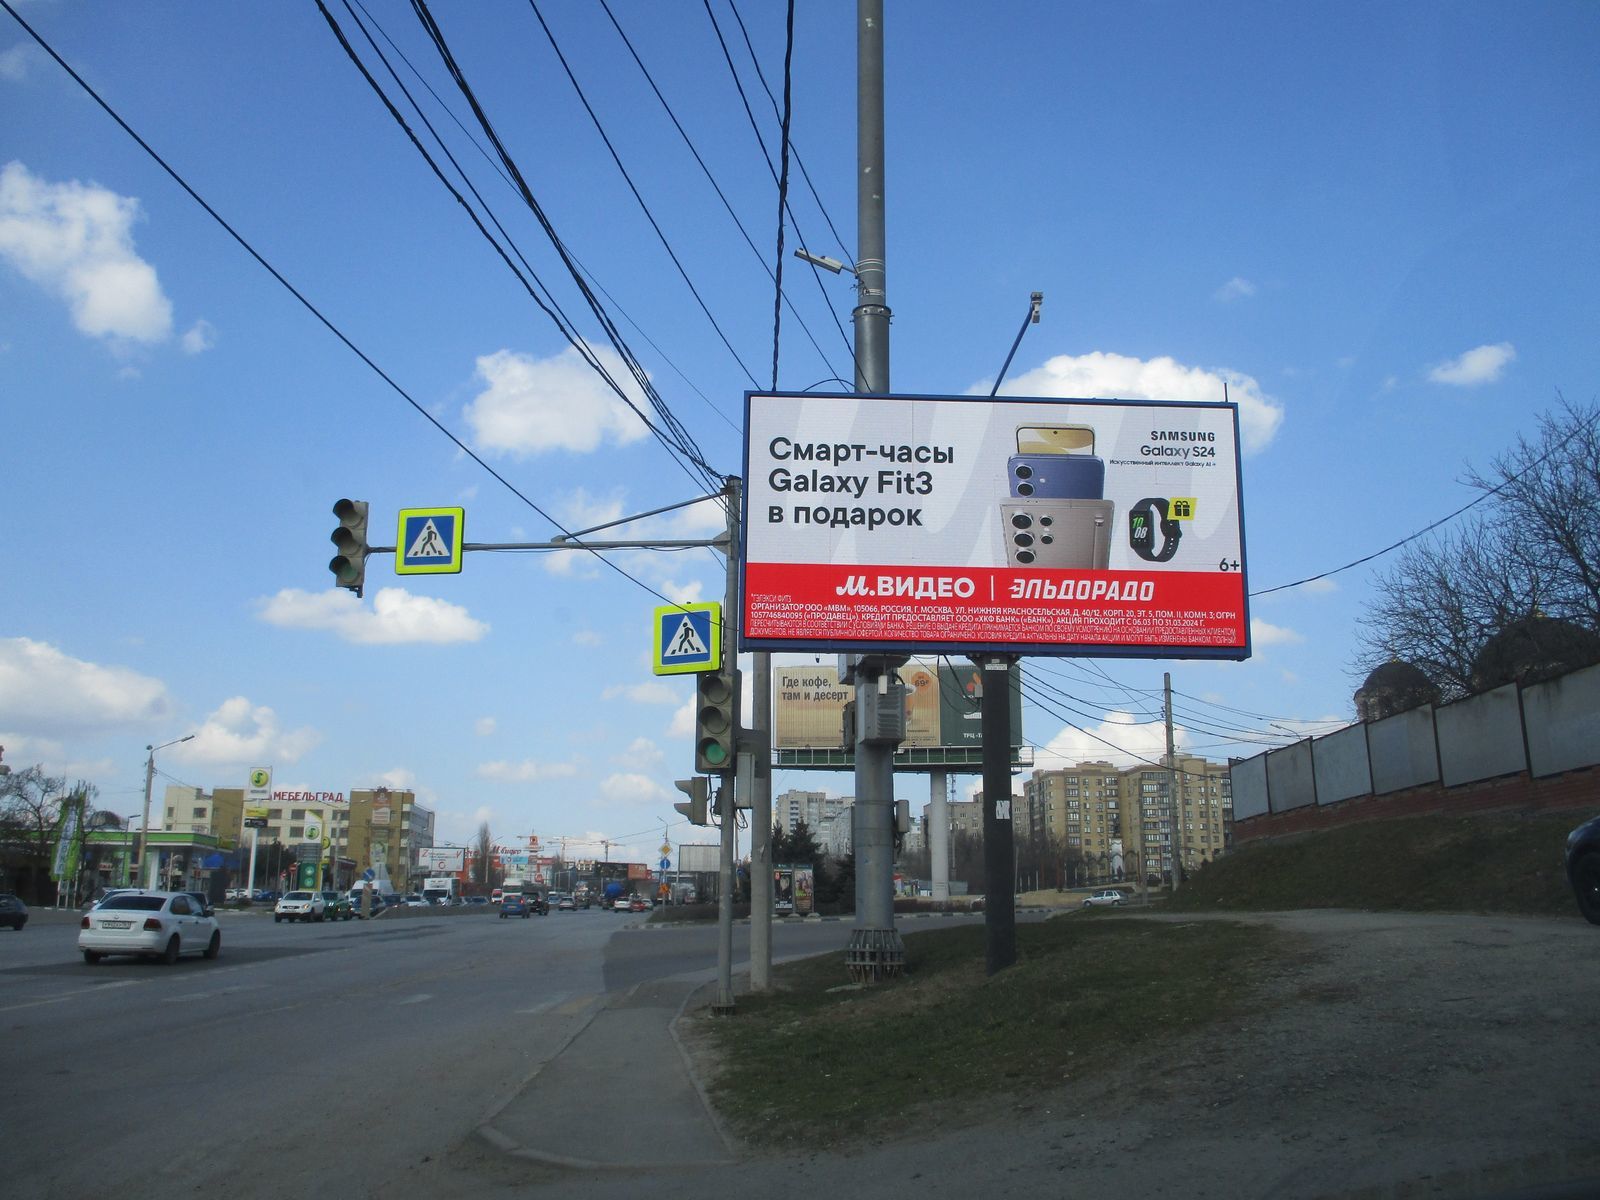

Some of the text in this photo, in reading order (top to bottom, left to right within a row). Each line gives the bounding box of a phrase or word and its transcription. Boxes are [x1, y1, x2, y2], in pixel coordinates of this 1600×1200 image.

[1151, 430, 1214, 442] SAMSUNG
[769, 436, 954, 466] Смарт-часы
[1140, 446, 1216, 459] Galaxy S24
[768, 468, 932, 498] Galaxy Fit3
[768, 506, 922, 530] в подарок
[1134, 527, 1148, 538] 08
[1219, 558, 1240, 571] 6+
[1008, 578, 1155, 601] ЭЛЬДОРАДО
[892, 613, 954, 622] ПРЕДОСТАВЛЯЕТ
[1083, 617, 1124, 625] ПРОХОДИТ
[782, 676, 831, 688] Где кофе,
[782, 692, 848, 702] там и десерт
[273, 792, 344, 802] МЕБЕЛЬГРАД
